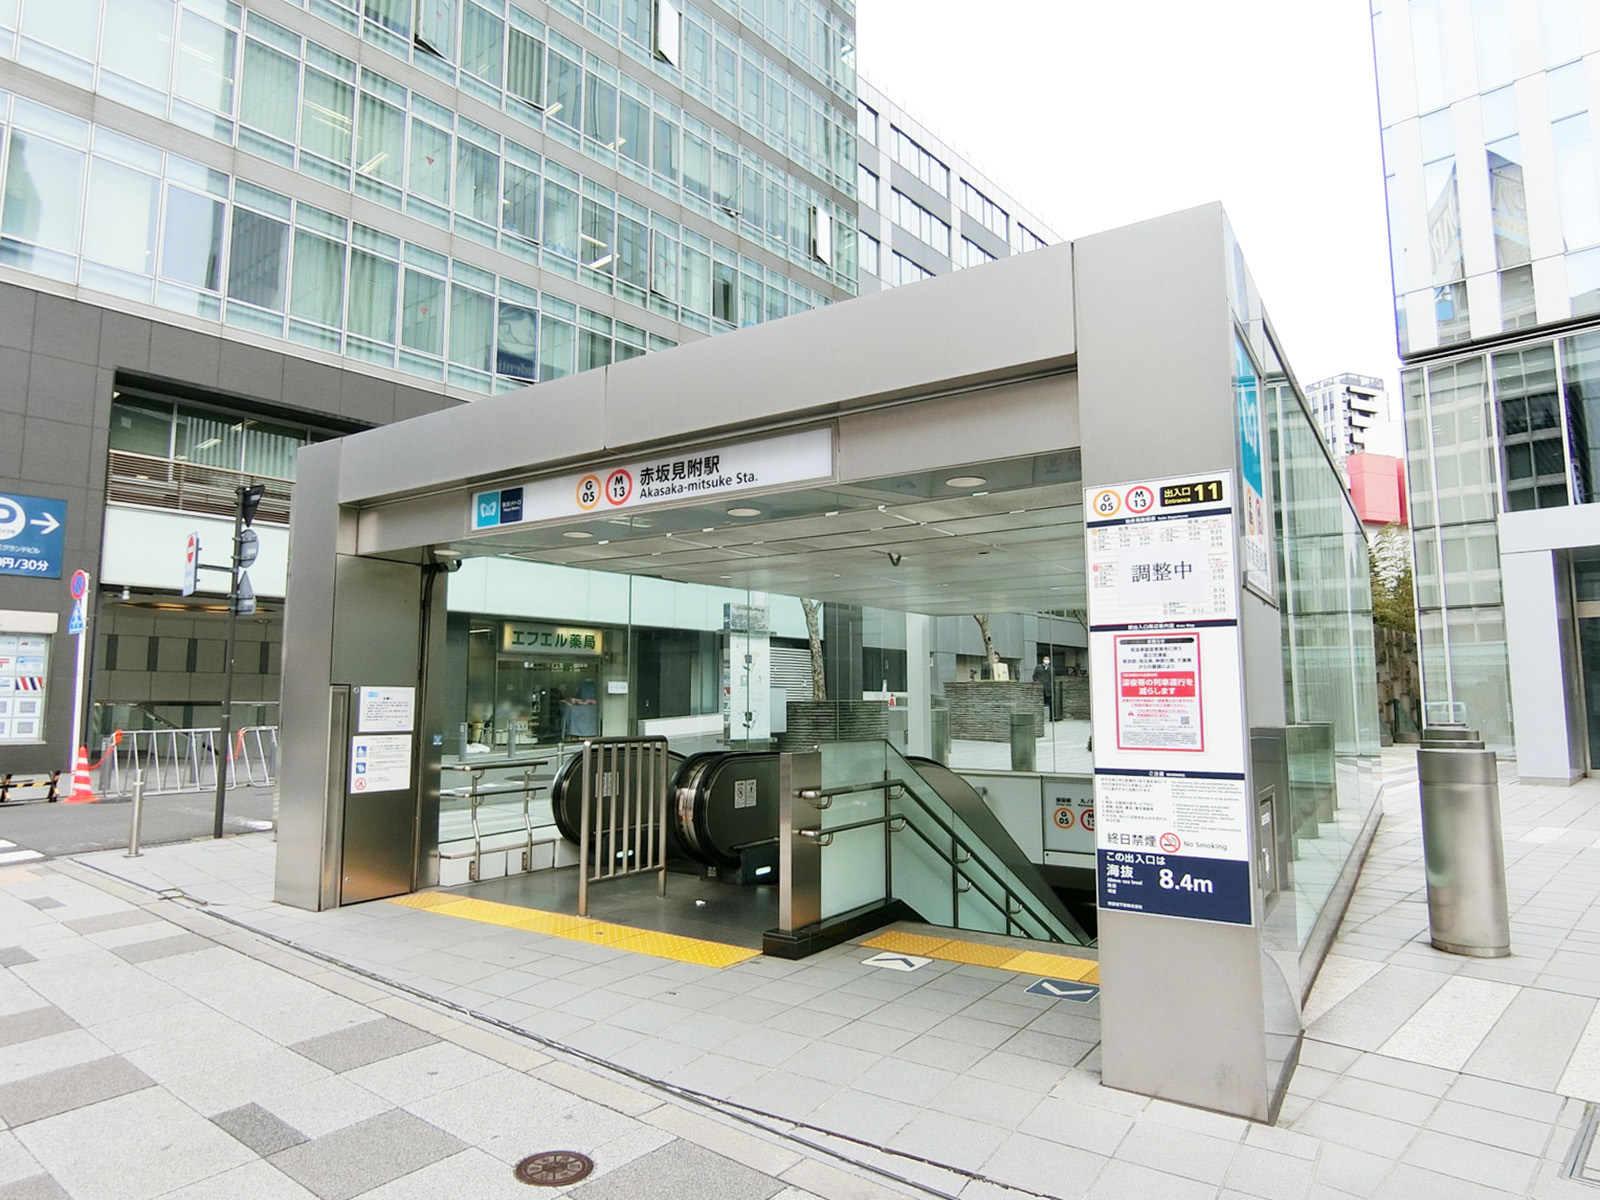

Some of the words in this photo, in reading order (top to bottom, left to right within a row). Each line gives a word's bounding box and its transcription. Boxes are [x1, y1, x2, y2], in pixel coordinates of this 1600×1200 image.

[639, 455, 720, 486] 赤坂見附駅
[585, 480, 593, 491] G
[614, 475, 624, 485] M
[639, 474, 732, 499] Akasaka-mitsuke
[736, 471, 758, 484] Sta.
[582, 491, 595, 503] 05
[613, 487, 625, 498] 13
[1135, 491, 1144, 499] M
[1164, 486, 1191, 498] 出入口
[1194, 482, 1218, 501] 11
[1102, 494, 1111, 502] G
[1134, 499, 1147, 508] 13
[1164, 497, 1191, 505] Entrance
[1100, 502, 1114, 511] 05
[0, 544, 41, 554] グランドビル
[0, 556, 49, 571] 円/30分
[1131, 560, 1192, 583] 調整中
[511, 630, 596, 650] エフエル薬局
[1107, 832, 1156, 847] 終日禁煙
[1195, 842, 1228, 852] Smoking
[1106, 851, 1166, 866] この出入口は
[1106, 863, 1134, 879] 海抜
[1159, 868, 1213, 894] 8.4m
